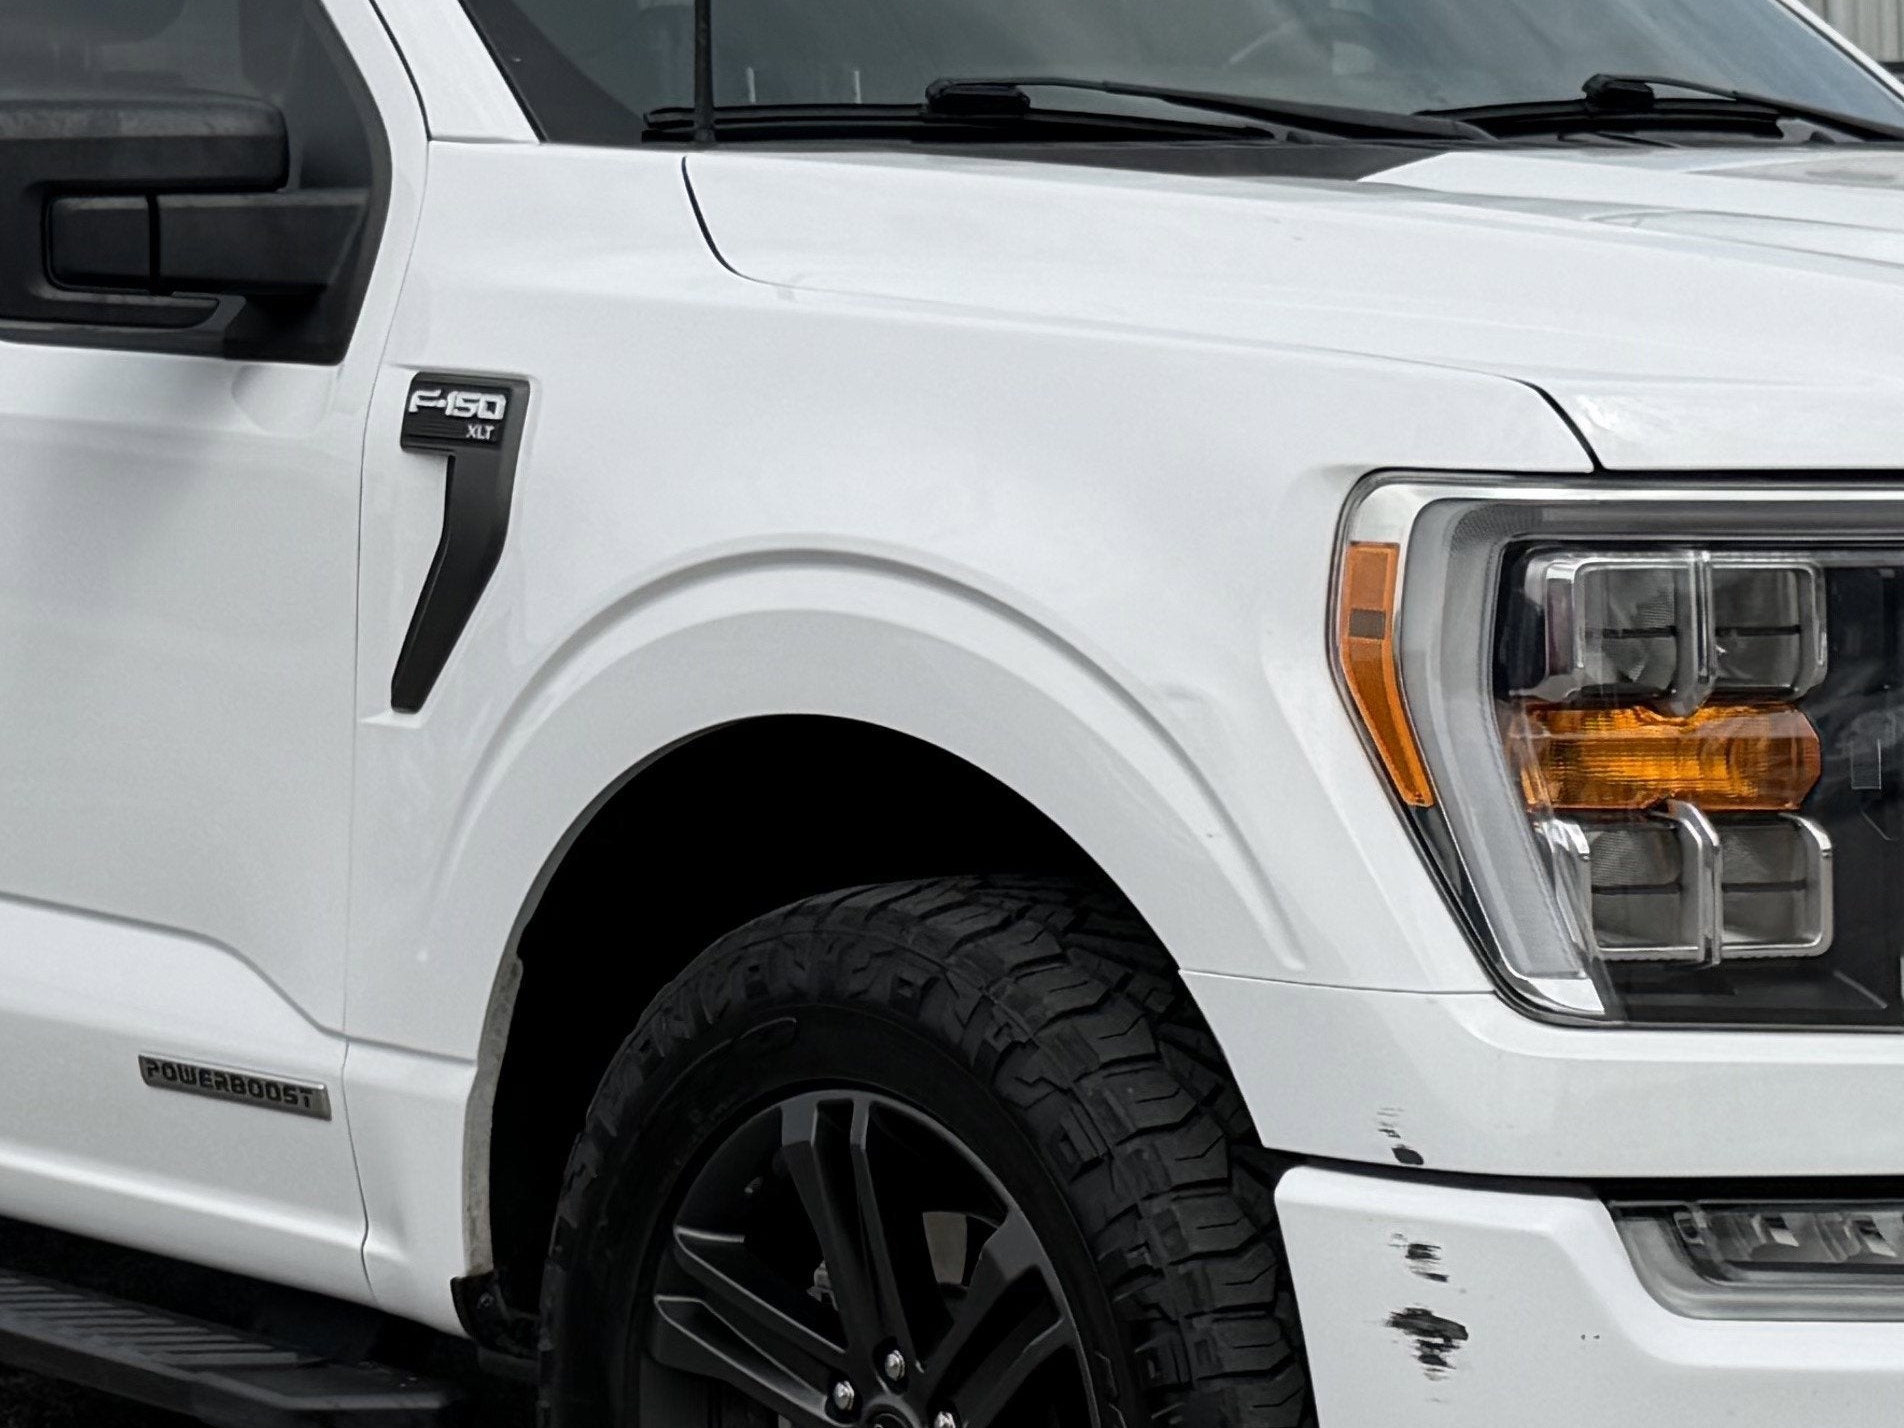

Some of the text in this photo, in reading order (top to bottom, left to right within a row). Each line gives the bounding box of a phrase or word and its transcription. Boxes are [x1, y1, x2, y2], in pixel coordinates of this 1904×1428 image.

[408, 388, 507, 421] F-150
[465, 423, 496, 440] XLT
[143, 1059, 314, 1110] POWERBOOST
